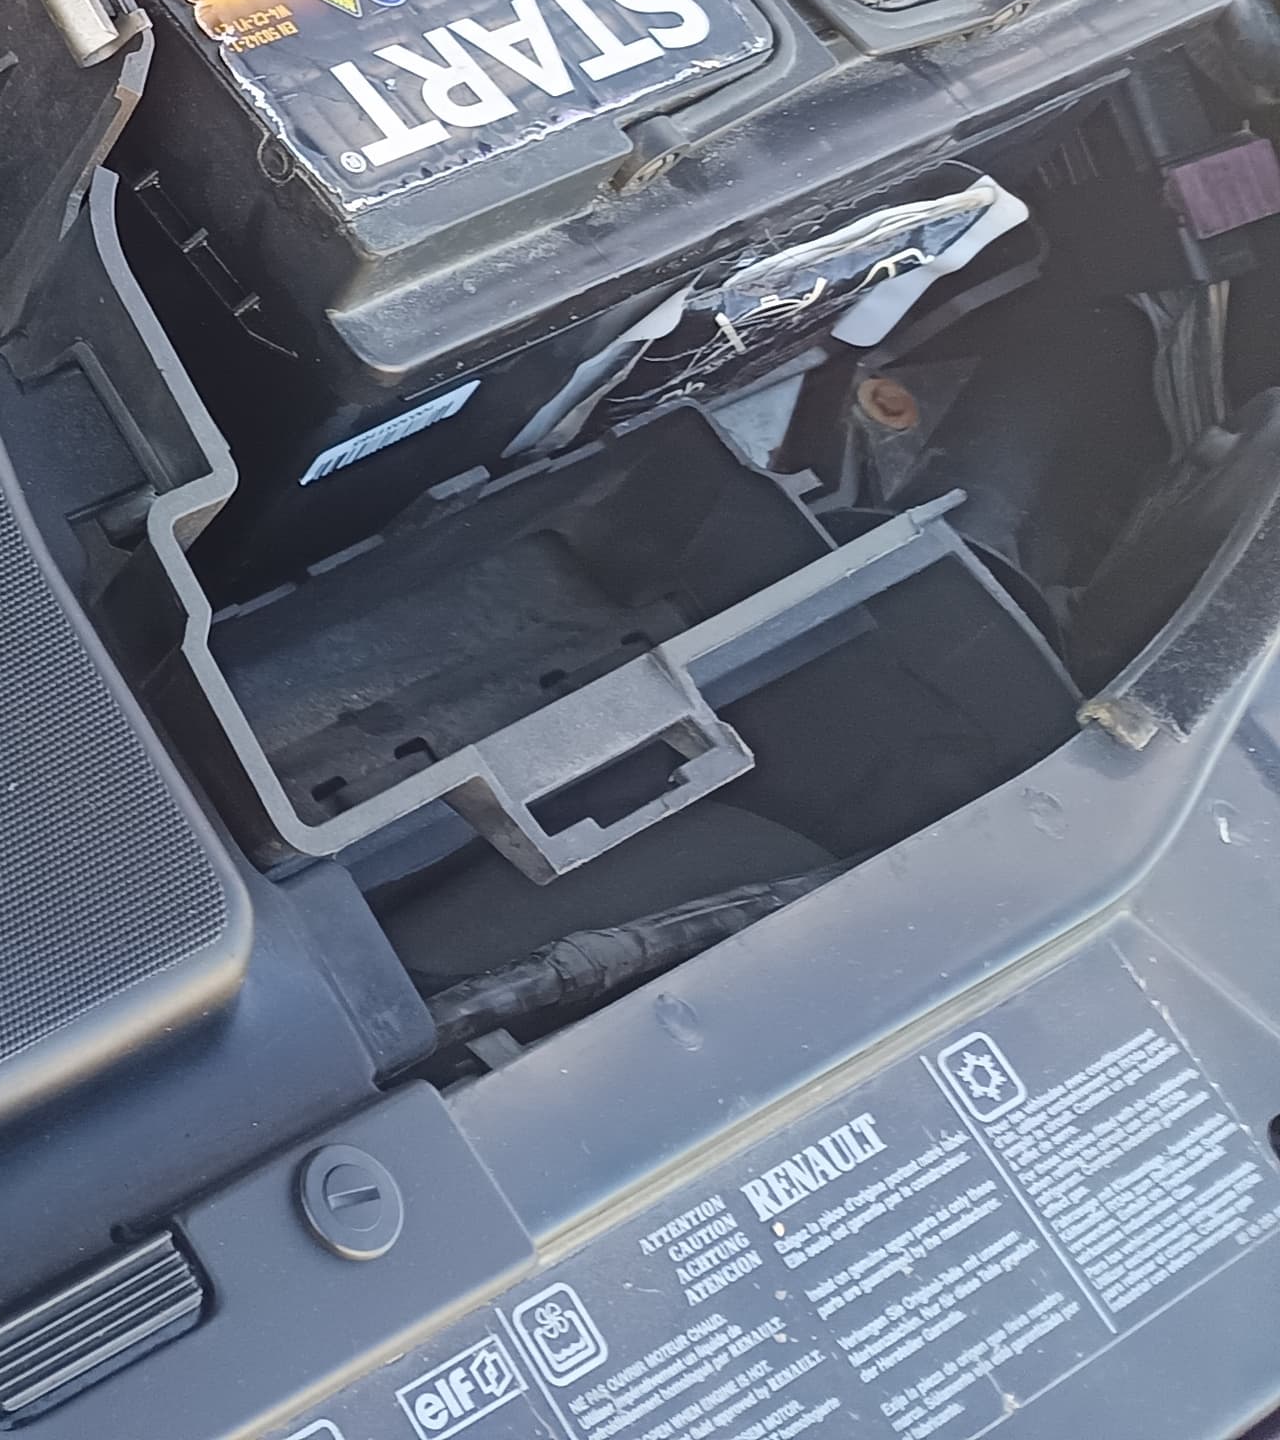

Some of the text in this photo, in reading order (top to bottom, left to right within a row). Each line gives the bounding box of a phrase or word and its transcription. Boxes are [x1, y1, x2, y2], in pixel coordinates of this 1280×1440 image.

[739, 1112, 888, 1222] RENAULT
[638, 1194, 727, 1255] ATTENTION
[668, 1212, 738, 1262] CAUTION
[675, 1231, 750, 1285] ACHTUNG
[684, 1249, 763, 1306] ATENCION
[643, 1334, 691, 1368] MOTEUR
[726, 1316, 786, 1357] RENAULT.
[414, 1366, 475, 1430] elf
[668, 1402, 704, 1429] WHEN
[734, 1373, 751, 1388] IS
[752, 1385, 771, 1400] by
[765, 1349, 826, 1391] RENAULT.
